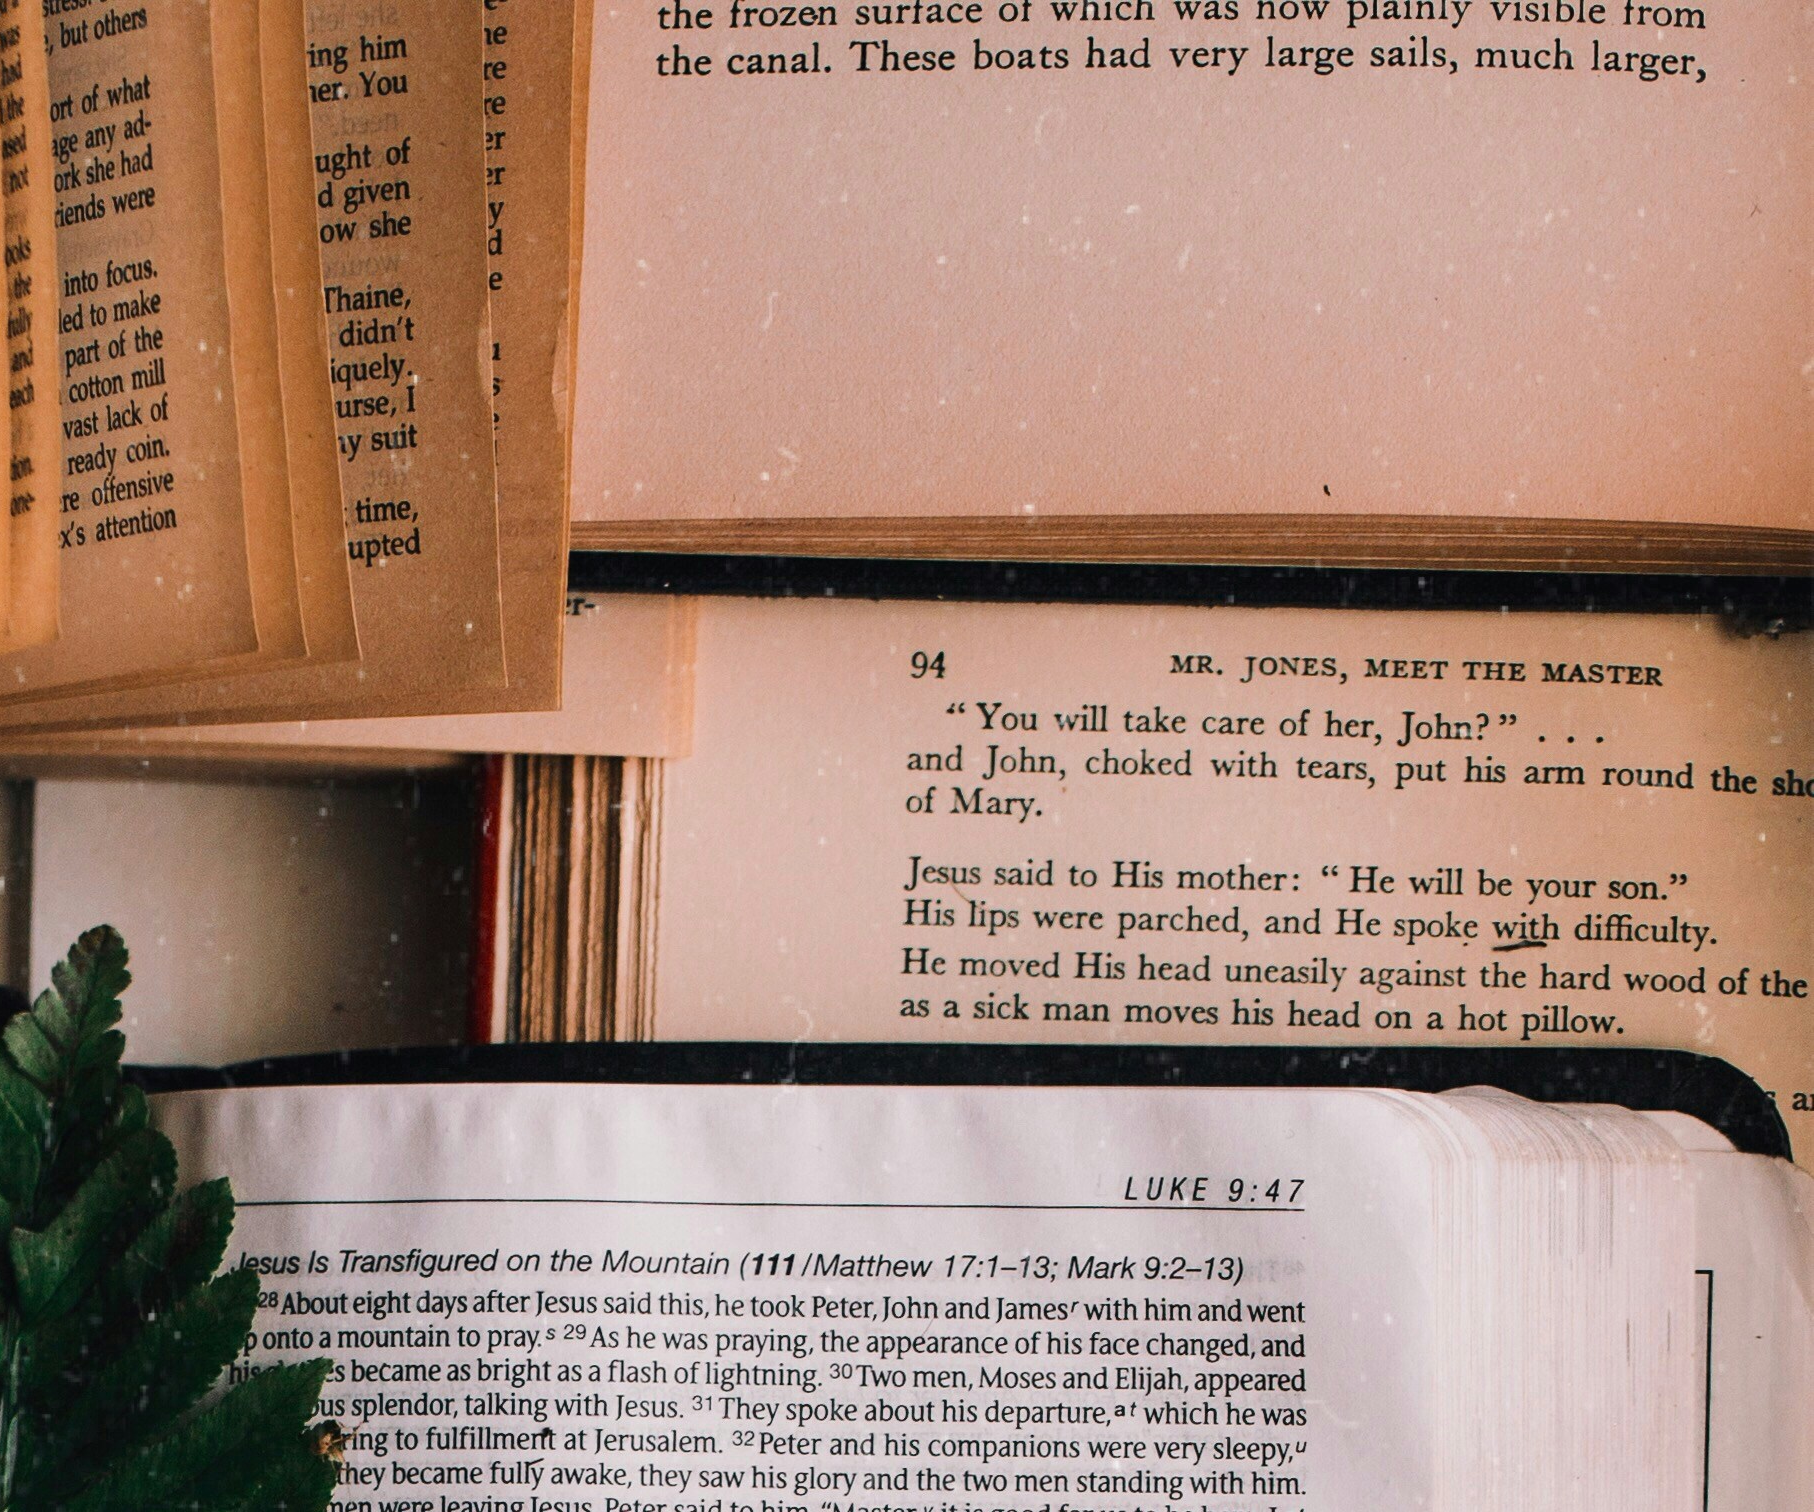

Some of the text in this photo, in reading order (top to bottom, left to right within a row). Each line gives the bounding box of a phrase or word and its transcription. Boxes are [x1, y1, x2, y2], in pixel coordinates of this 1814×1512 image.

[657, 36, 1706, 83] the canal. These boats had very large sails, much larger,
[64, 260, 158, 297] into focus.
[339, 316, 414, 347] didn't
[65, 326, 163, 378] part of the
[69, 357, 166, 403] cotton mill
[68, 434, 170, 476] ready coin.
[911, 651, 945, 678] 94
[1170, 655, 1663, 686] MR. JONES, MEET THE MASTER
[906, 786, 1042, 823] of Mary.
[904, 899, 1717, 952] His lips were parched, and He spoke with difficulty.
[1125, 1177, 1304, 1202] LUKE 9:47
[340, 1249, 499, 1278] Transfigured
[507, 1254, 540, 1271] on
[551, 1249, 592, 1272] the
[602, 1250, 729, 1274] Mountain
[1068, 1256, 1136, 1279] Mark
